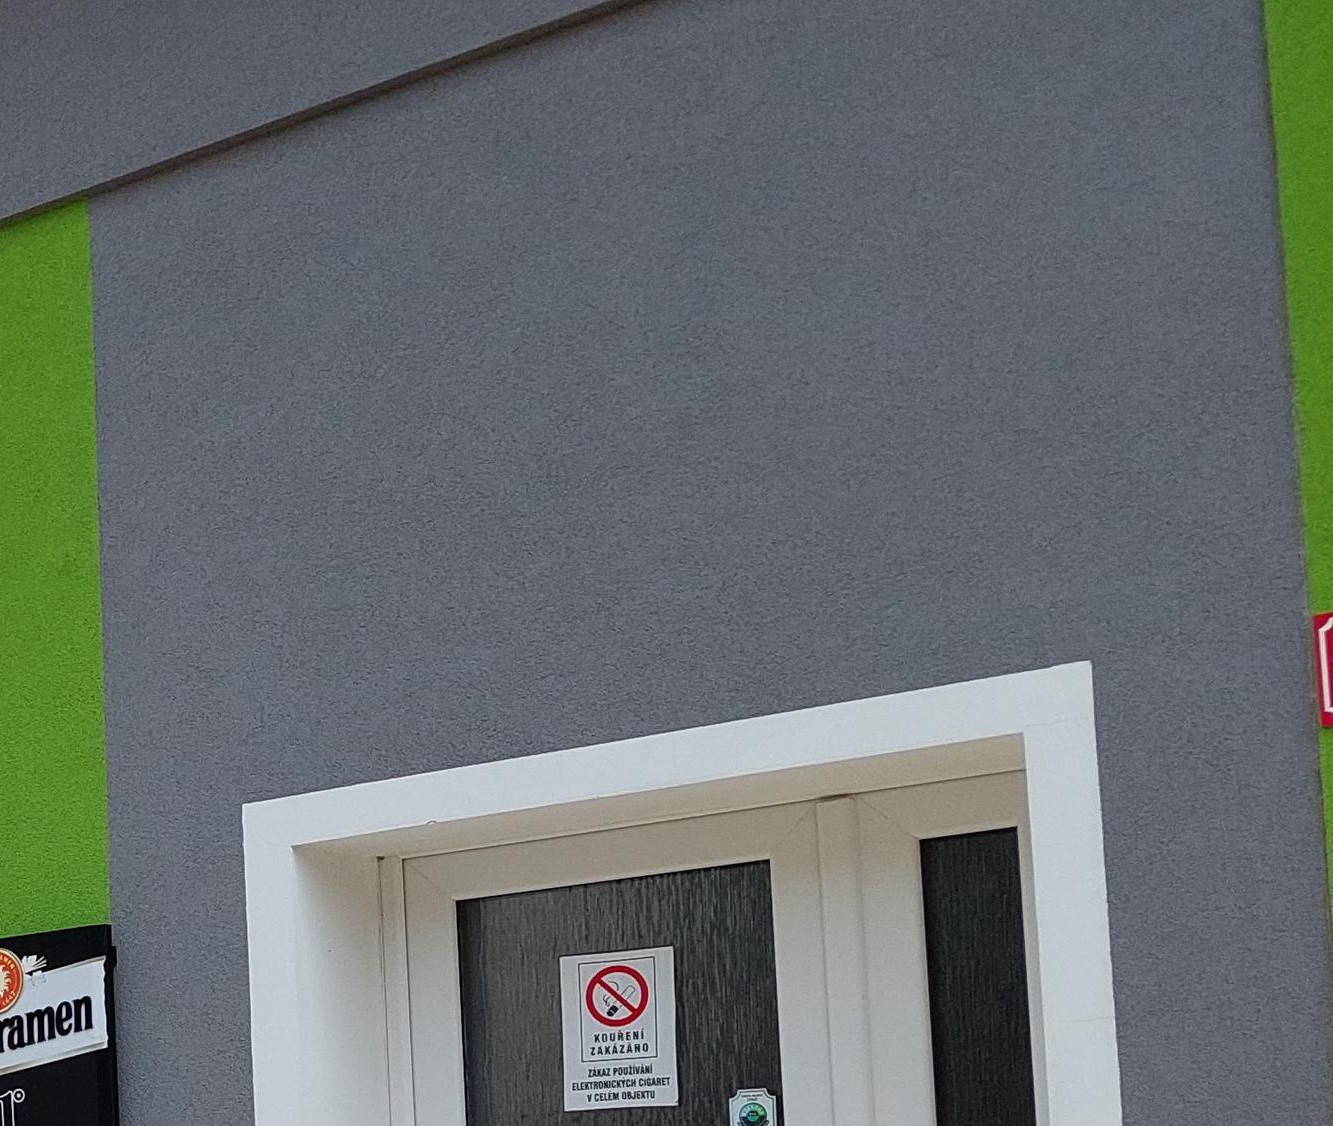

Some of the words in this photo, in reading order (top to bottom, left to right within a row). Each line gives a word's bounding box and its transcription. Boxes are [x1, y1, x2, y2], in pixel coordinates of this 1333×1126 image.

[594, 1028, 644, 1043] KOUŘENÍ
[589, 1043, 649, 1056] ZAKÁZÁNO
[588, 1066, 611, 1078] ZÁKAZ
[613, 1063, 653, 1076] POUŽÍVÁNÍ
[572, 1077, 637, 1091] ELEKTRONICKÝCH
[638, 1077, 671, 1087] CIGARET
[587, 1094, 592, 1102] V
[594, 1090, 620, 1102] CELÉM
[621, 1090, 655, 1100] OBJEKTU
